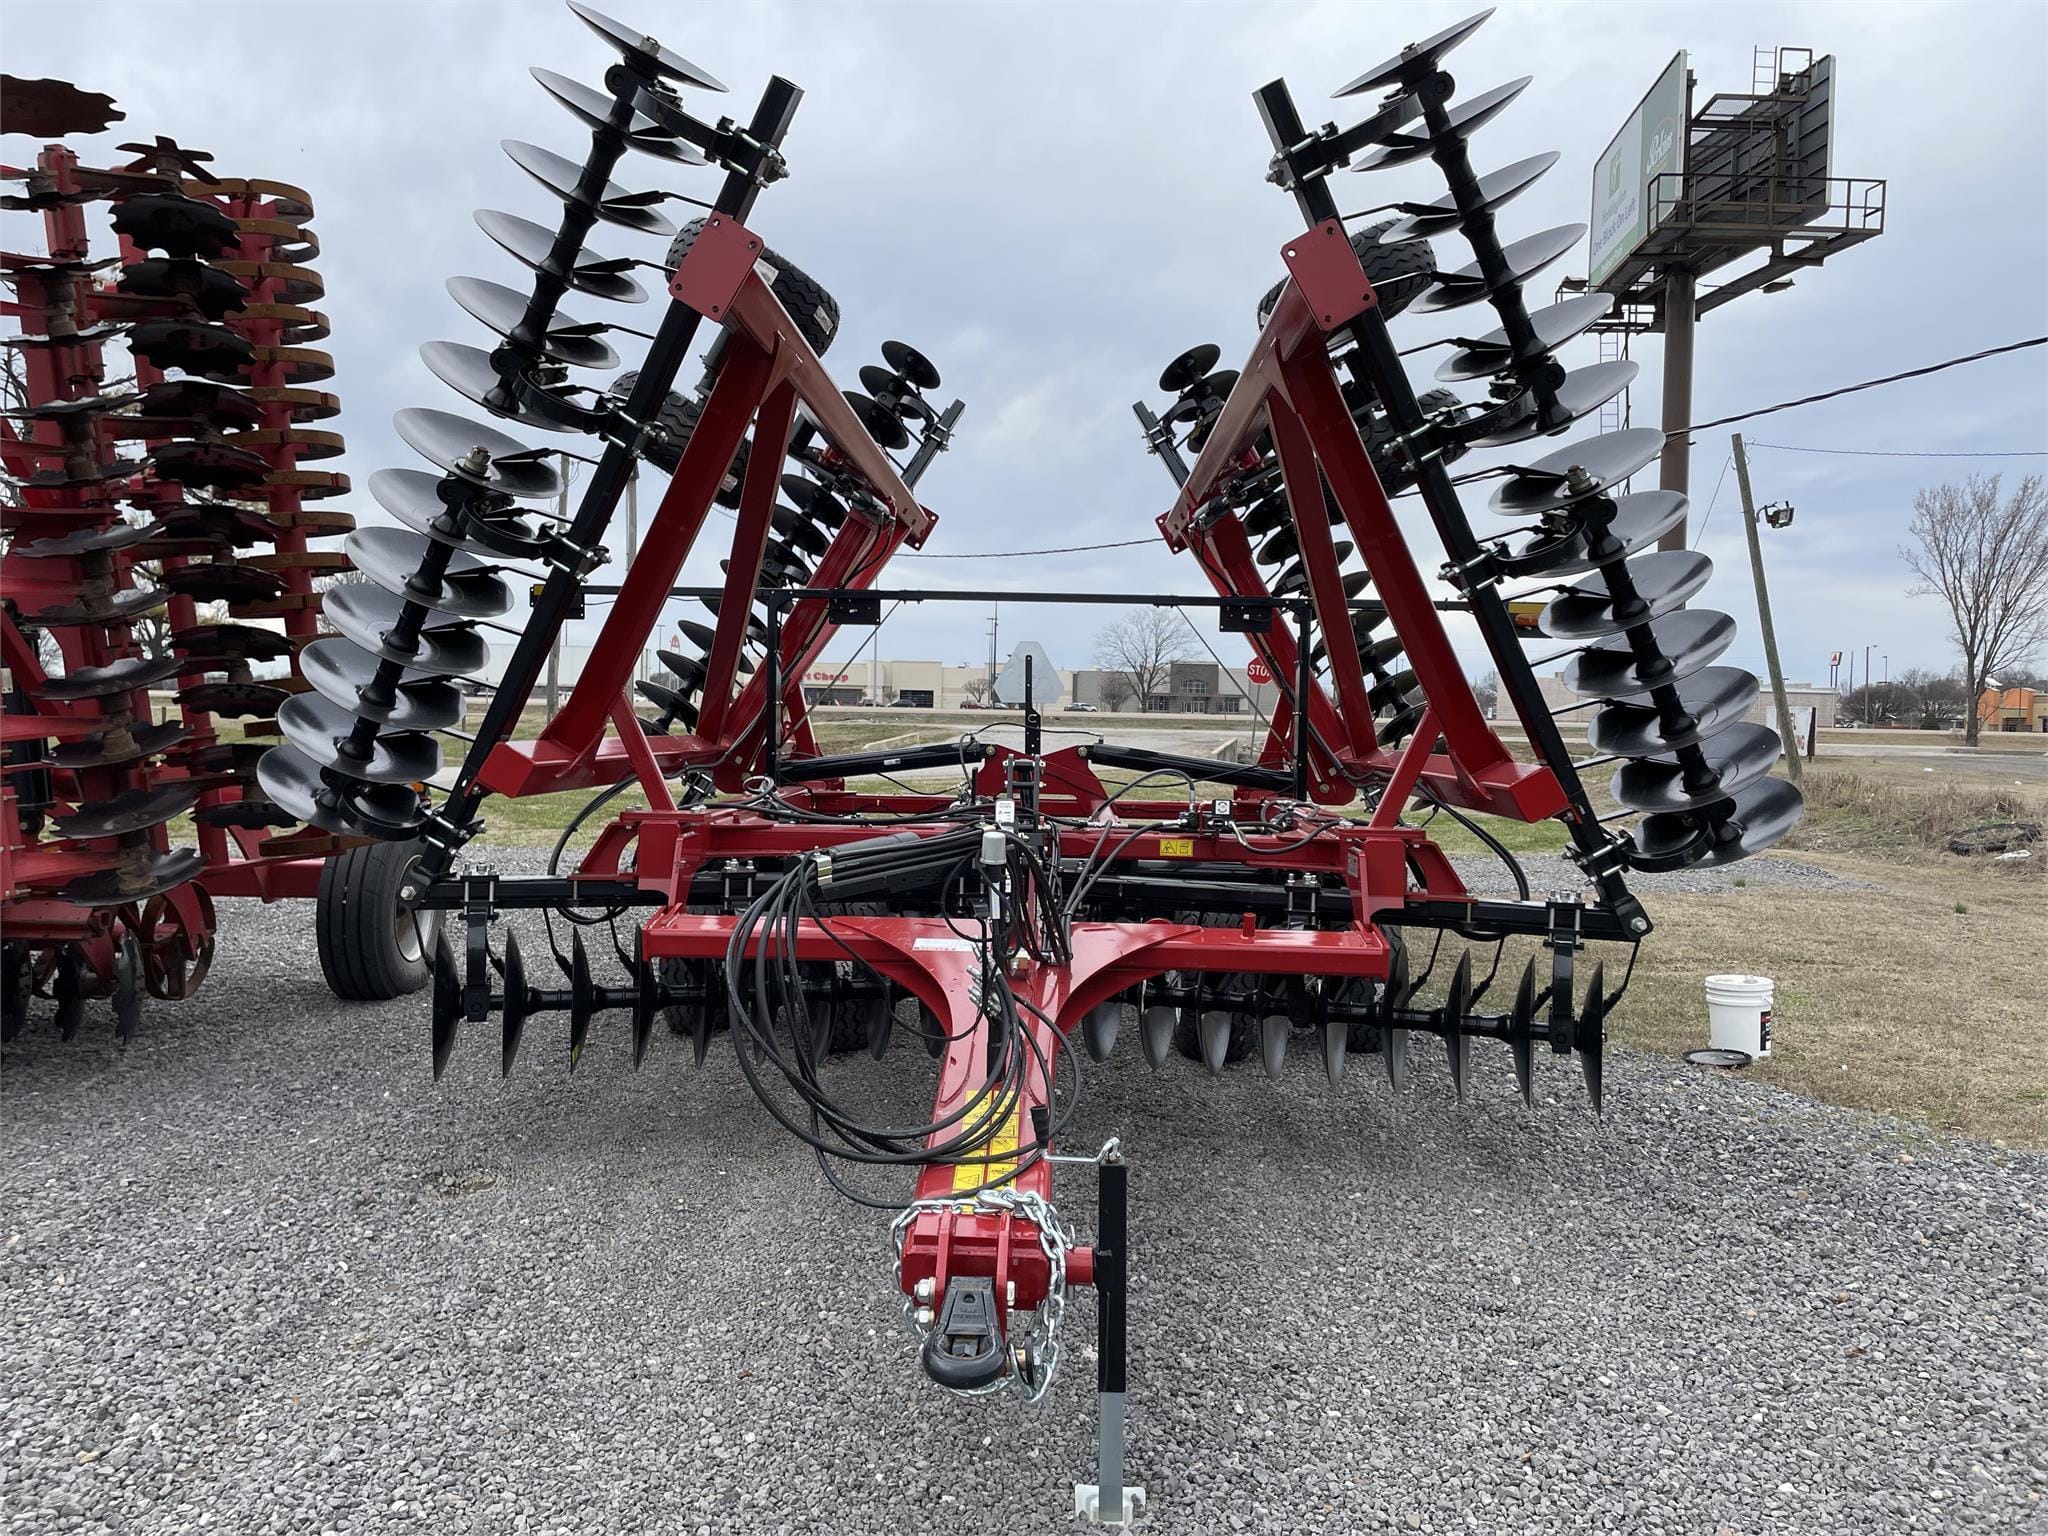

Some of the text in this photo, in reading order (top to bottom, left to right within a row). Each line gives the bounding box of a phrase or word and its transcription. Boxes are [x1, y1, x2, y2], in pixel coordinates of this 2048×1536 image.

[1593, 198, 1635, 256] One Block On Left
[1248, 664, 1270, 677] STO
